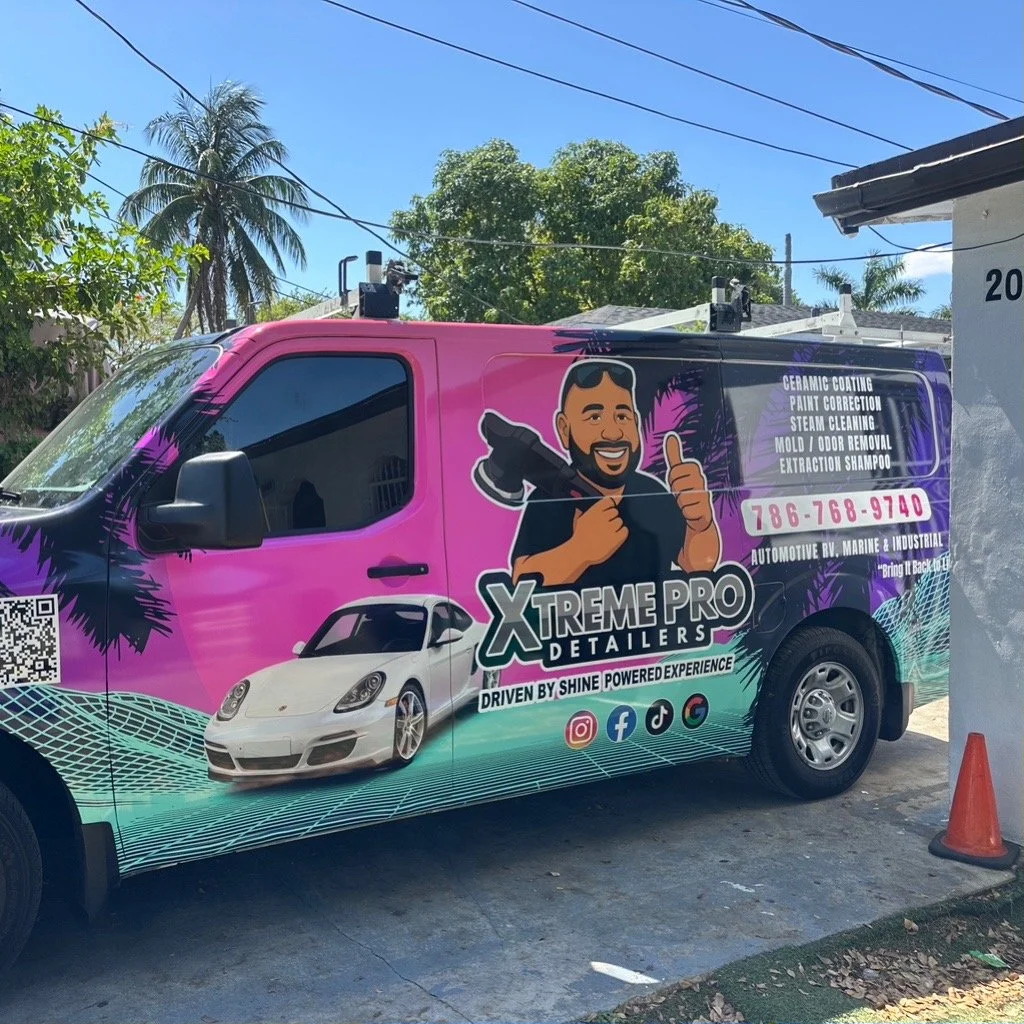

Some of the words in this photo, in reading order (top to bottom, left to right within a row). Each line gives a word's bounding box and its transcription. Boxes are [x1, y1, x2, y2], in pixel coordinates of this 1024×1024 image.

[985, 268, 1023, 302] 20
[783, 375, 829, 392] CERAMIC
[832, 376, 873, 392] COATING
[789, 396, 819, 411] PAINT
[823, 395, 882, 412] CORRECTION
[790, 416, 825, 432] STEAM
[828, 415, 875, 431] CLEANING
[775, 436, 804, 453] MOLD
[809, 437, 814, 452] /
[818, 436, 845, 451] ODOR
[847, 435, 892, 451] REMOVAL
[779, 455, 841, 474] EXTRACTION
[844, 454, 891, 471] SHAMPOO
[752, 493, 924, 531] 786-768-9740
[751, 543, 818, 566] AUTOMOTIVE
[843, 537, 880, 556] MARINE
[883, 538, 889, 552] &
[893, 532, 943, 552] INDUSTRIAL
[905, 560, 911, 576] It
[912, 559, 931, 575] Back
[486, 580, 655, 657] XTREME
[663, 573, 746, 625] PRO
[550, 624, 706, 661] DETAILERS
[481, 689, 534, 710] DRIVEN
[537, 682, 555, 700] BY
[559, 675, 600, 696] SHINE
[604, 667, 662, 689] POWERED
[664, 656, 734, 680] EXPERIENCE
